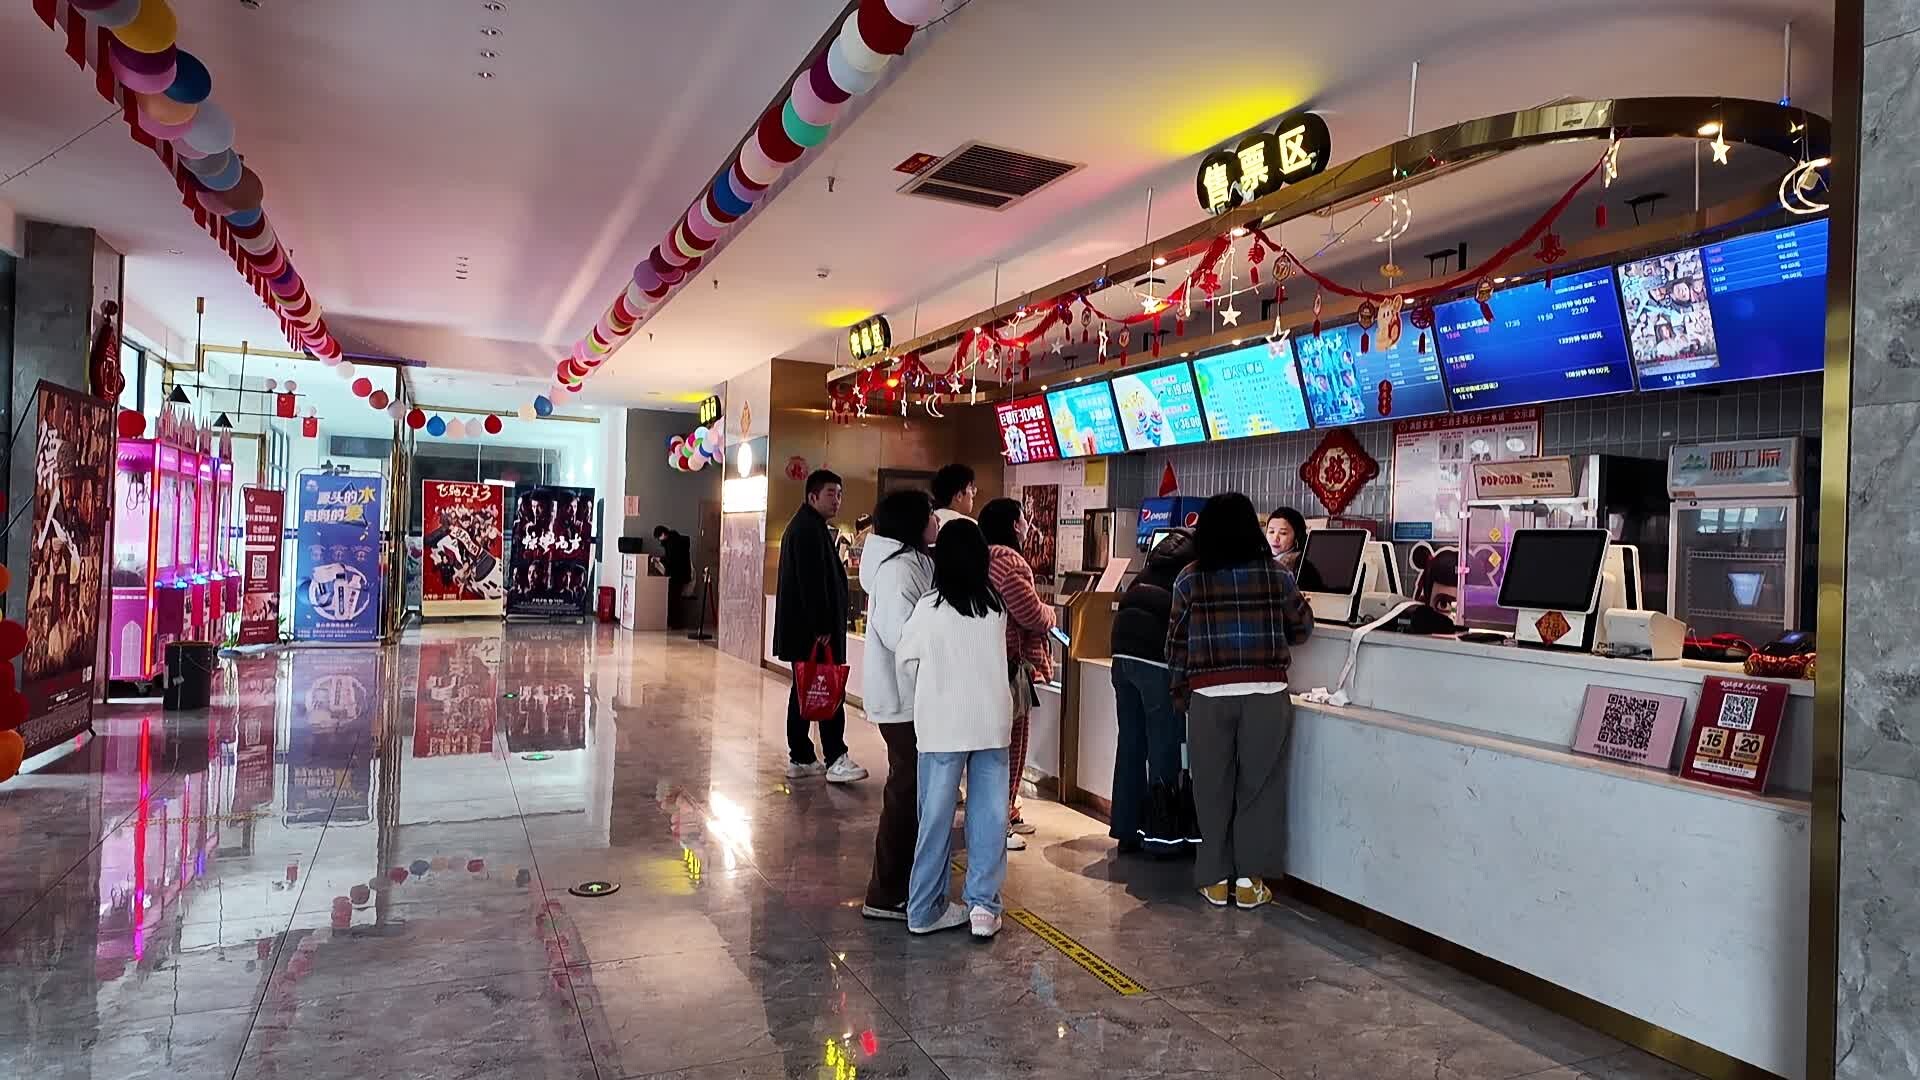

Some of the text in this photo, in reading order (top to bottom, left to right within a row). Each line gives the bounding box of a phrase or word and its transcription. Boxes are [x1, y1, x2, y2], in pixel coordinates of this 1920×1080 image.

[1203, 124, 1312, 213] 售票区
[1481, 474, 1523, 486] POPCORN
